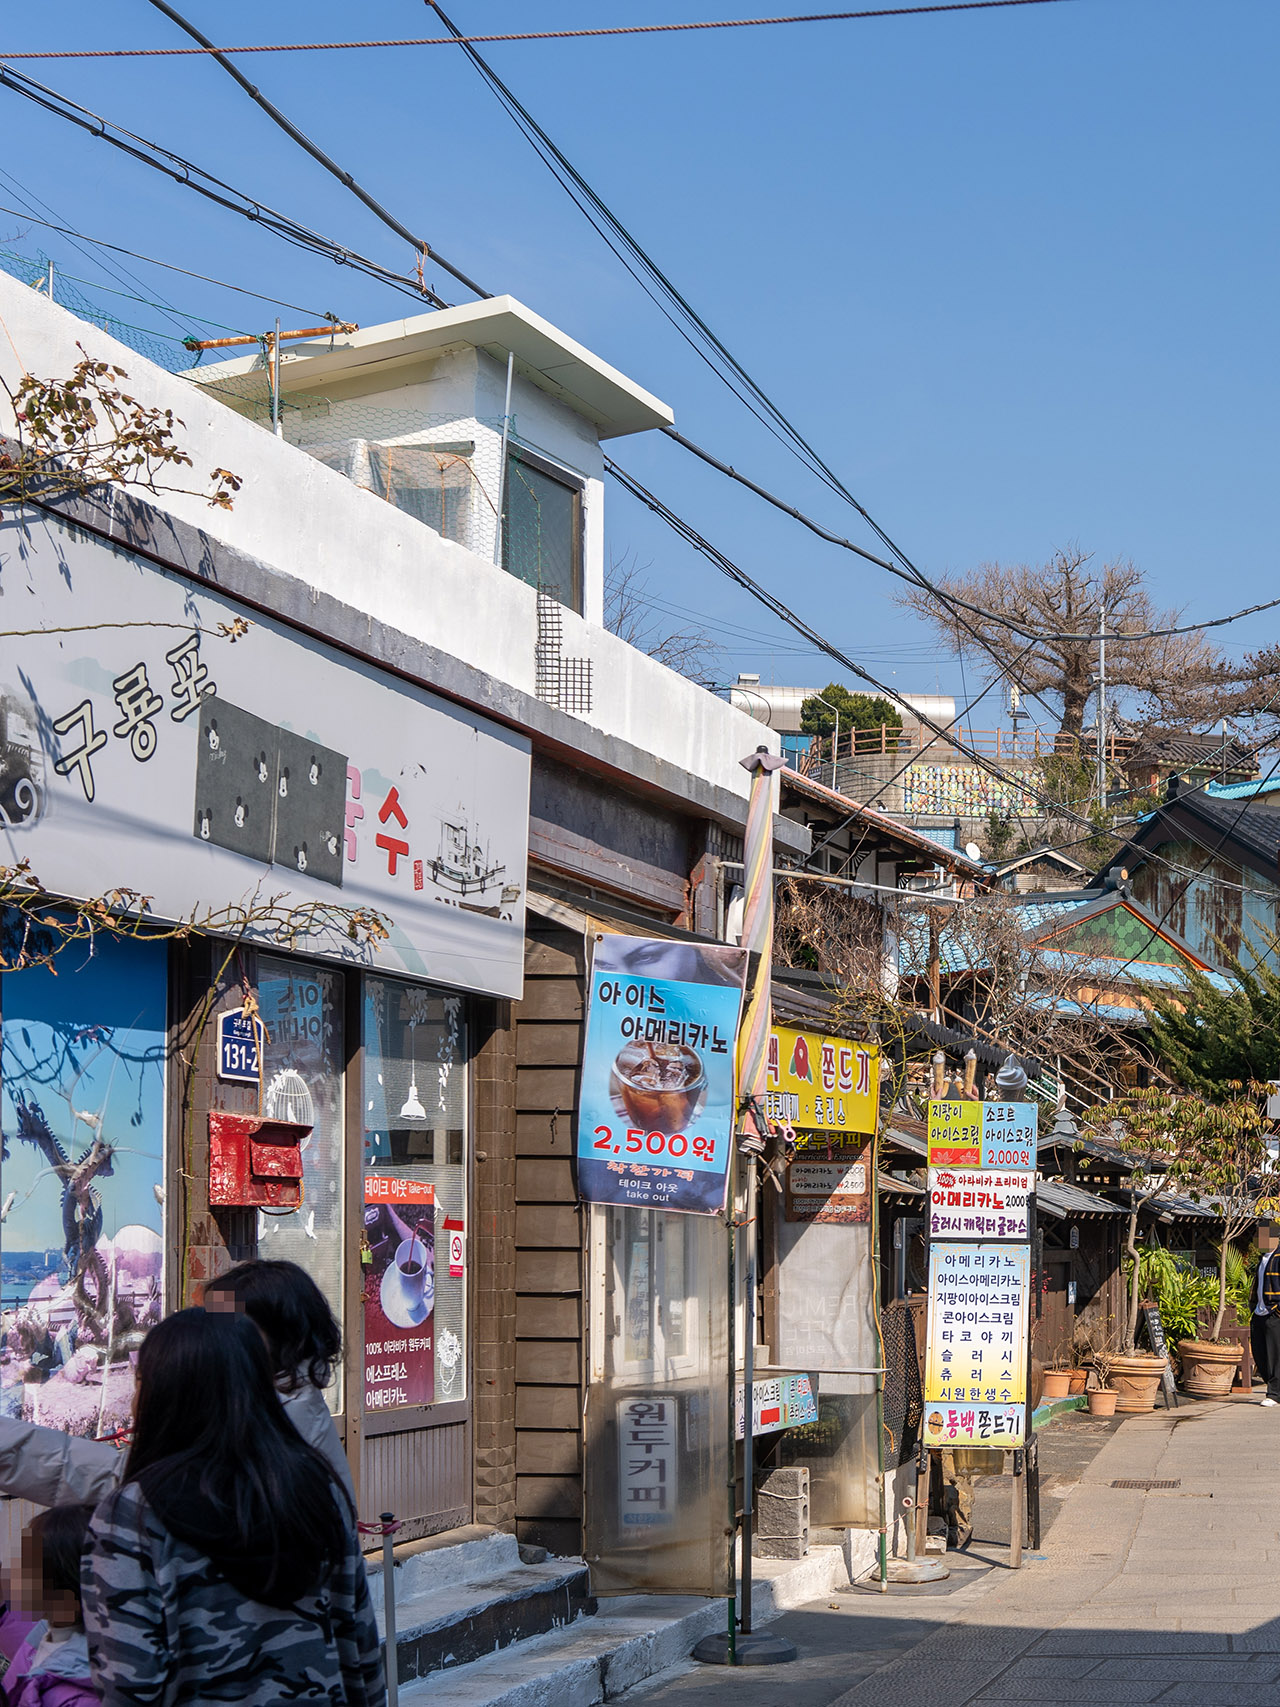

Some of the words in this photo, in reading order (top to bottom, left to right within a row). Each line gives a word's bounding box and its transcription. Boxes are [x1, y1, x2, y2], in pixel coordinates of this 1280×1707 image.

[53, 633, 217, 803] 구룡포
[598, 980, 666, 1014] 아이스
[620, 1016, 729, 1054] 아메리카노
[224, 1043, 260, 1072] 131-2
[821, 1044, 869, 1096] 쫀드기
[815, 1095, 846, 1125] 츄러스
[932, 1104, 962, 1122] 지팡이
[986, 1107, 1016, 1122] 소프트
[593, 1125, 716, 1162] 2,500원
[795, 1132, 861, 1150] 원두커피
[931, 1125, 979, 1145] 아이스크림
[985, 1126, 1033, 1147] 아이스크림
[987, 1149, 1030, 1166] 2,000원
[795, 1167, 833, 1175] 아메리카노
[391, 1180, 407, 1198] 아웃
[618, 1179, 652, 1191] 테이크
[656, 1183, 679, 1194] 아웃
[795, 1182, 833, 1190] 아메리카노
[958, 1174, 993, 1188] 아라비카
[994, 1176, 1028, 1189] 프리미엄
[626, 1190, 650, 1200] take
[652, 1194, 670, 1203] out
[931, 1190, 1004, 1209] 아메리카노
[930, 1213, 962, 1233] 슬러시
[997, 1216, 1027, 1236] 글라스
[945, 1255, 1016, 1268] 아메리카노
[937, 1273, 1021, 1287] 아이스아메리카노
[936, 1292, 1020, 1306] 지팡이아이스크림
[942, 1312, 1014, 1325] 콘아이스크림
[366, 1342, 382, 1355] 100%
[408, 1337, 431, 1353] 원두커피
[366, 1362, 408, 1384] 에소프레소
[366, 1387, 408, 1408] 아메리카노
[946, 1409, 975, 1438] 동백
[978, 1410, 1020, 1438] 쫀드기
[624, 1402, 670, 1511] 원두커피
